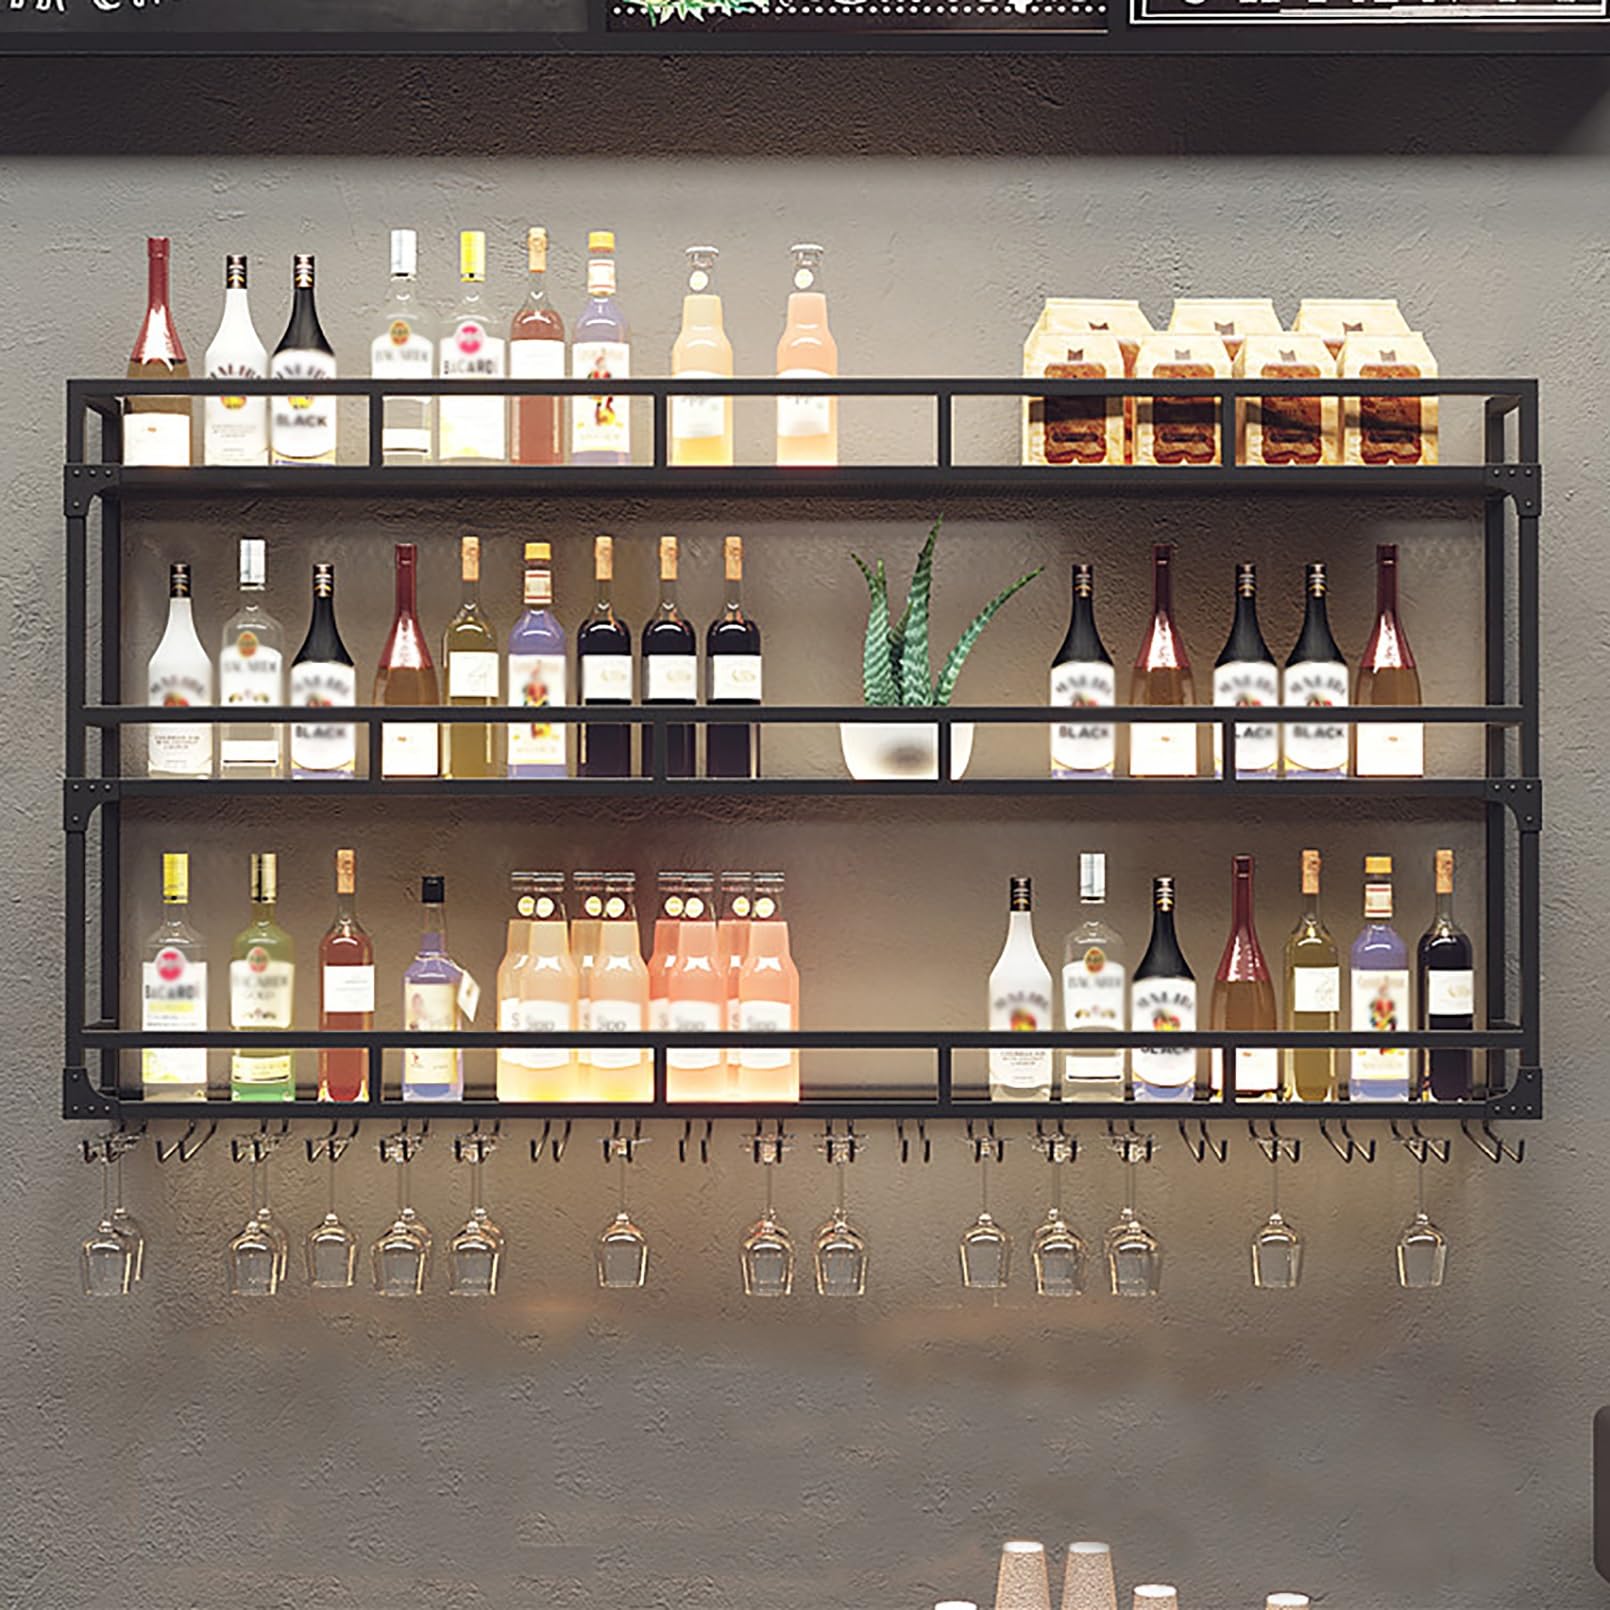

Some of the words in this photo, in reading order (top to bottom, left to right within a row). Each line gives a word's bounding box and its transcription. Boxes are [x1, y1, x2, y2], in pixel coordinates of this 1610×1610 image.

[276, 414, 327, 427] BLACK
[295, 726, 346, 738] BLACK
[1059, 726, 1109, 738] BLACK
[1293, 726, 1344, 738] BLACK
